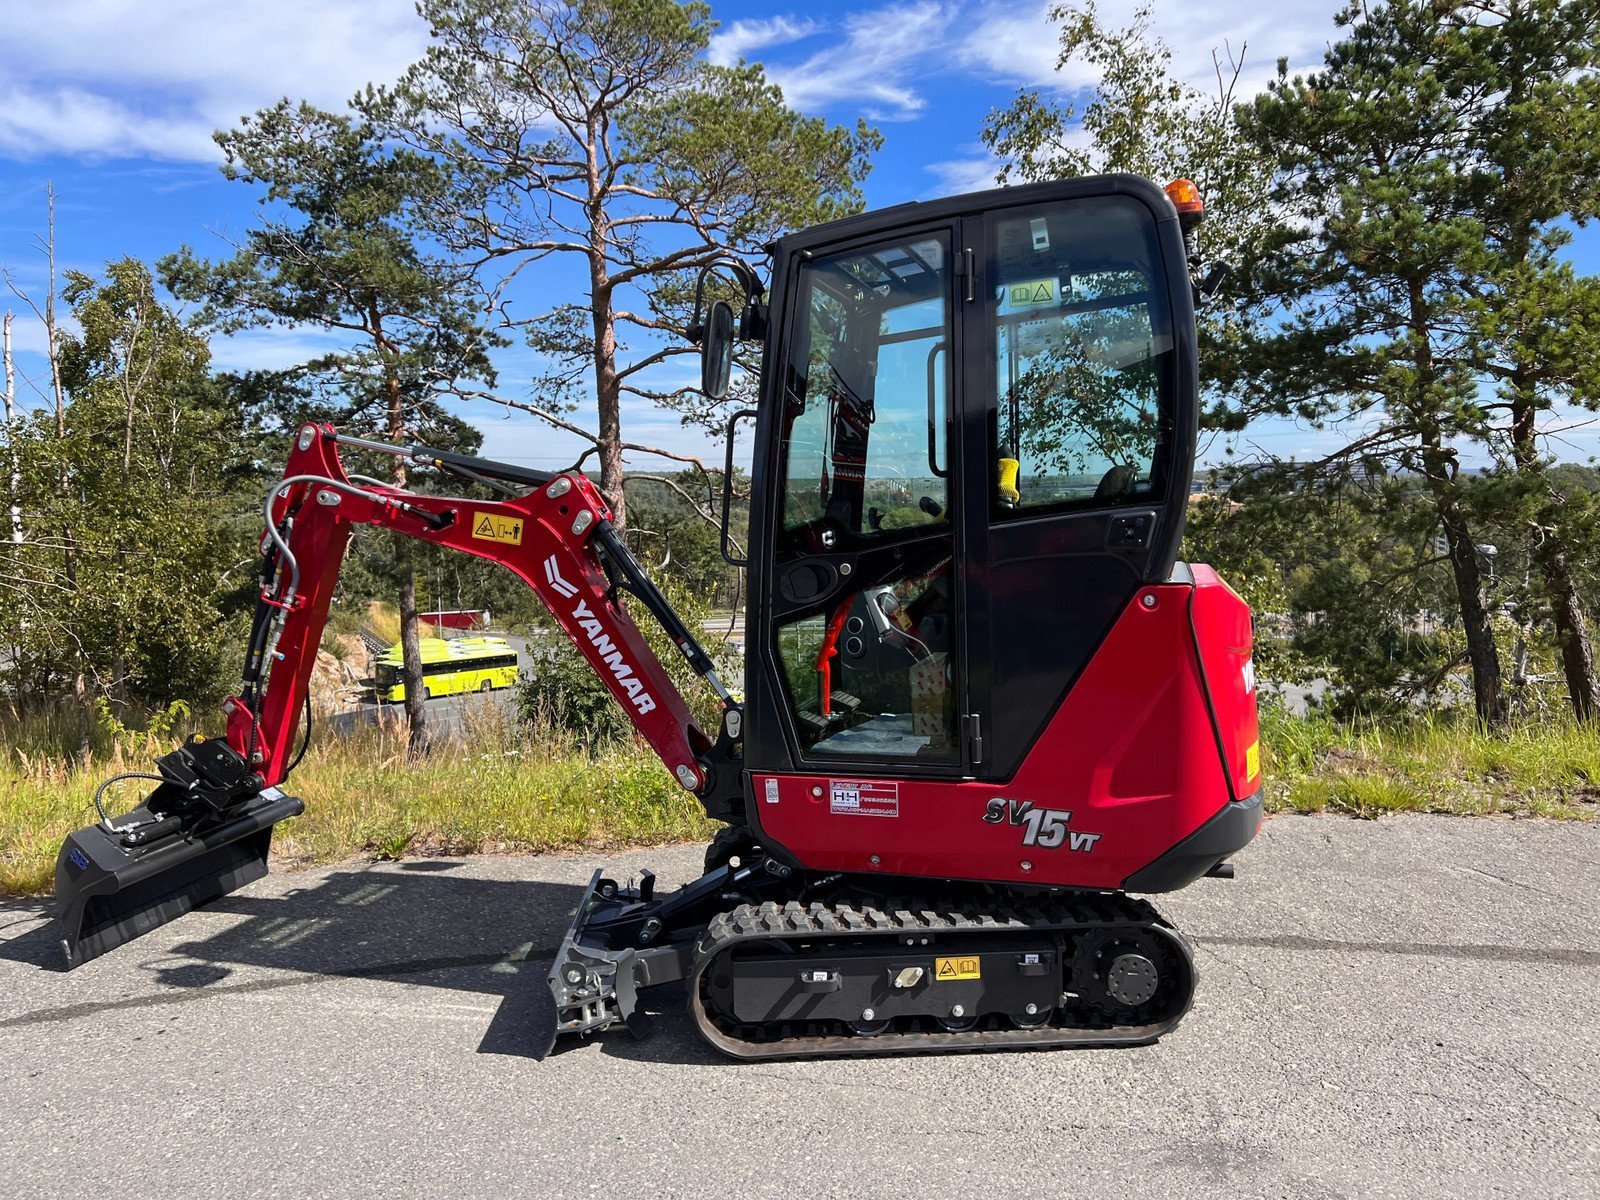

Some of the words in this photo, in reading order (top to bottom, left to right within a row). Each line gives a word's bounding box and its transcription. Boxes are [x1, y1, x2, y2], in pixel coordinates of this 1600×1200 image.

[572, 599, 657, 715] YANMAR
[982, 797, 1034, 826] SV
[1021, 807, 1073, 849] 15
[1068, 830, 1103, 853] VT
